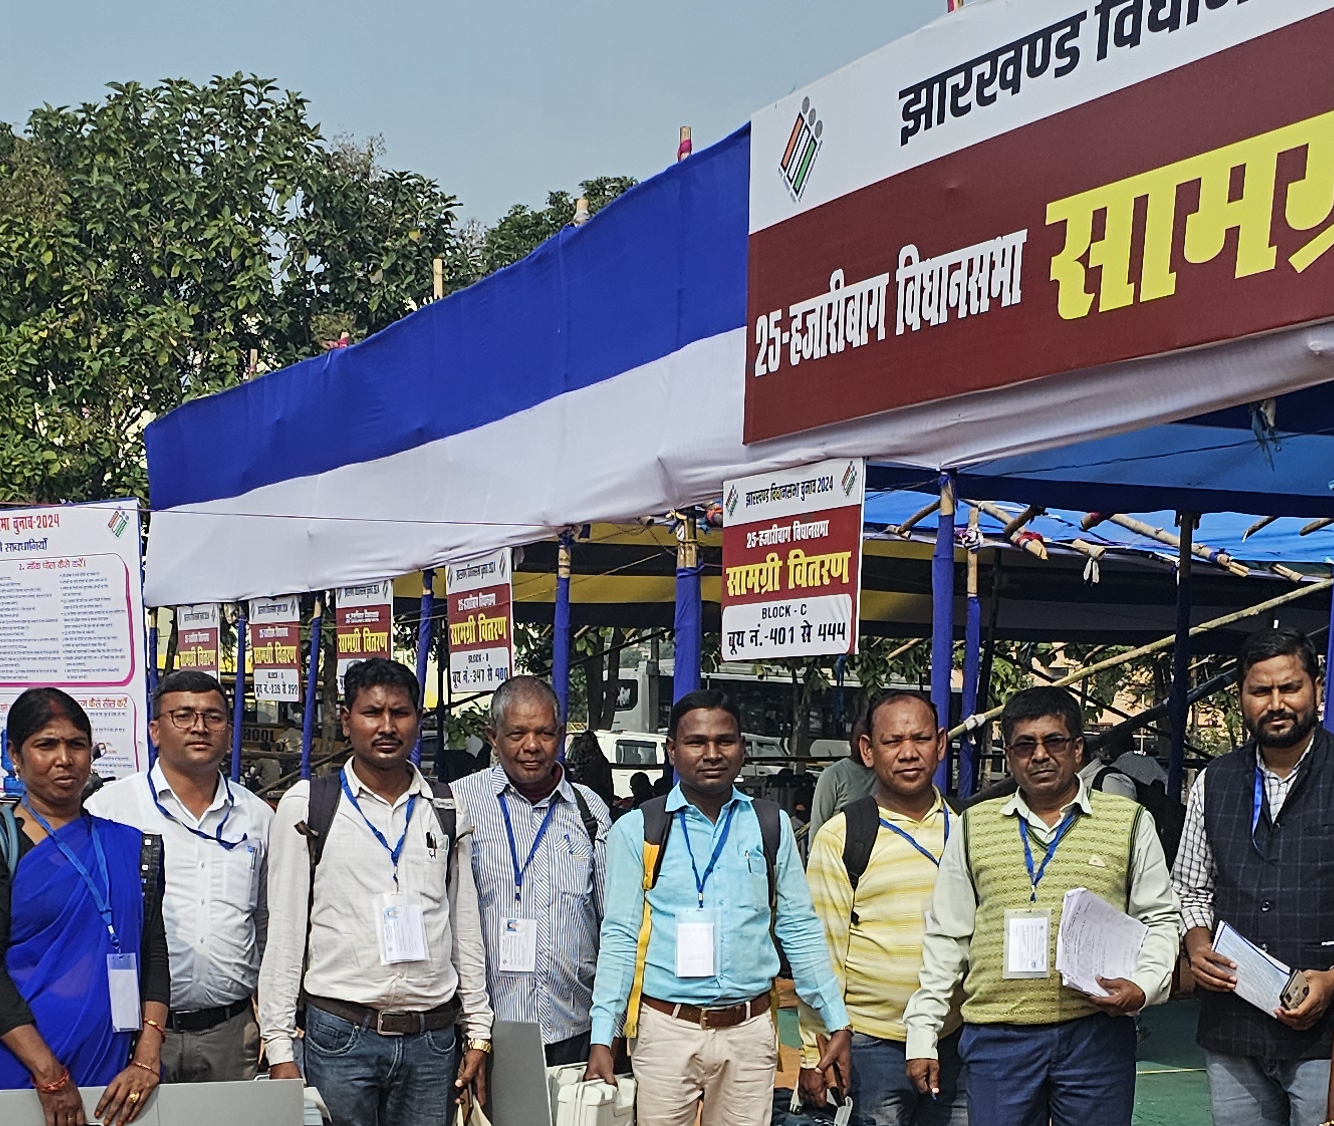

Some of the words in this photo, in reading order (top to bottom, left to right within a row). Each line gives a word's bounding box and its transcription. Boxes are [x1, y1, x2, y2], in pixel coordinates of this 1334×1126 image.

[898, 9, 1088, 147] झारखण्ड
[754, 268, 890, 377] 25-हजारीबाग
[895, 229, 1028, 336] विधानसभा
[817, 475, 834, 493] 2024
[725, 552, 783, 597] सामग्री
[787, 548, 852, 590] वितरण
[761, 604, 791, 620] BLOCK
[800, 603, 808, 615] C
[478, 613, 507, 643] वितरण
[800, 619, 813, 643] से
[817, 622, 846, 642] 444
